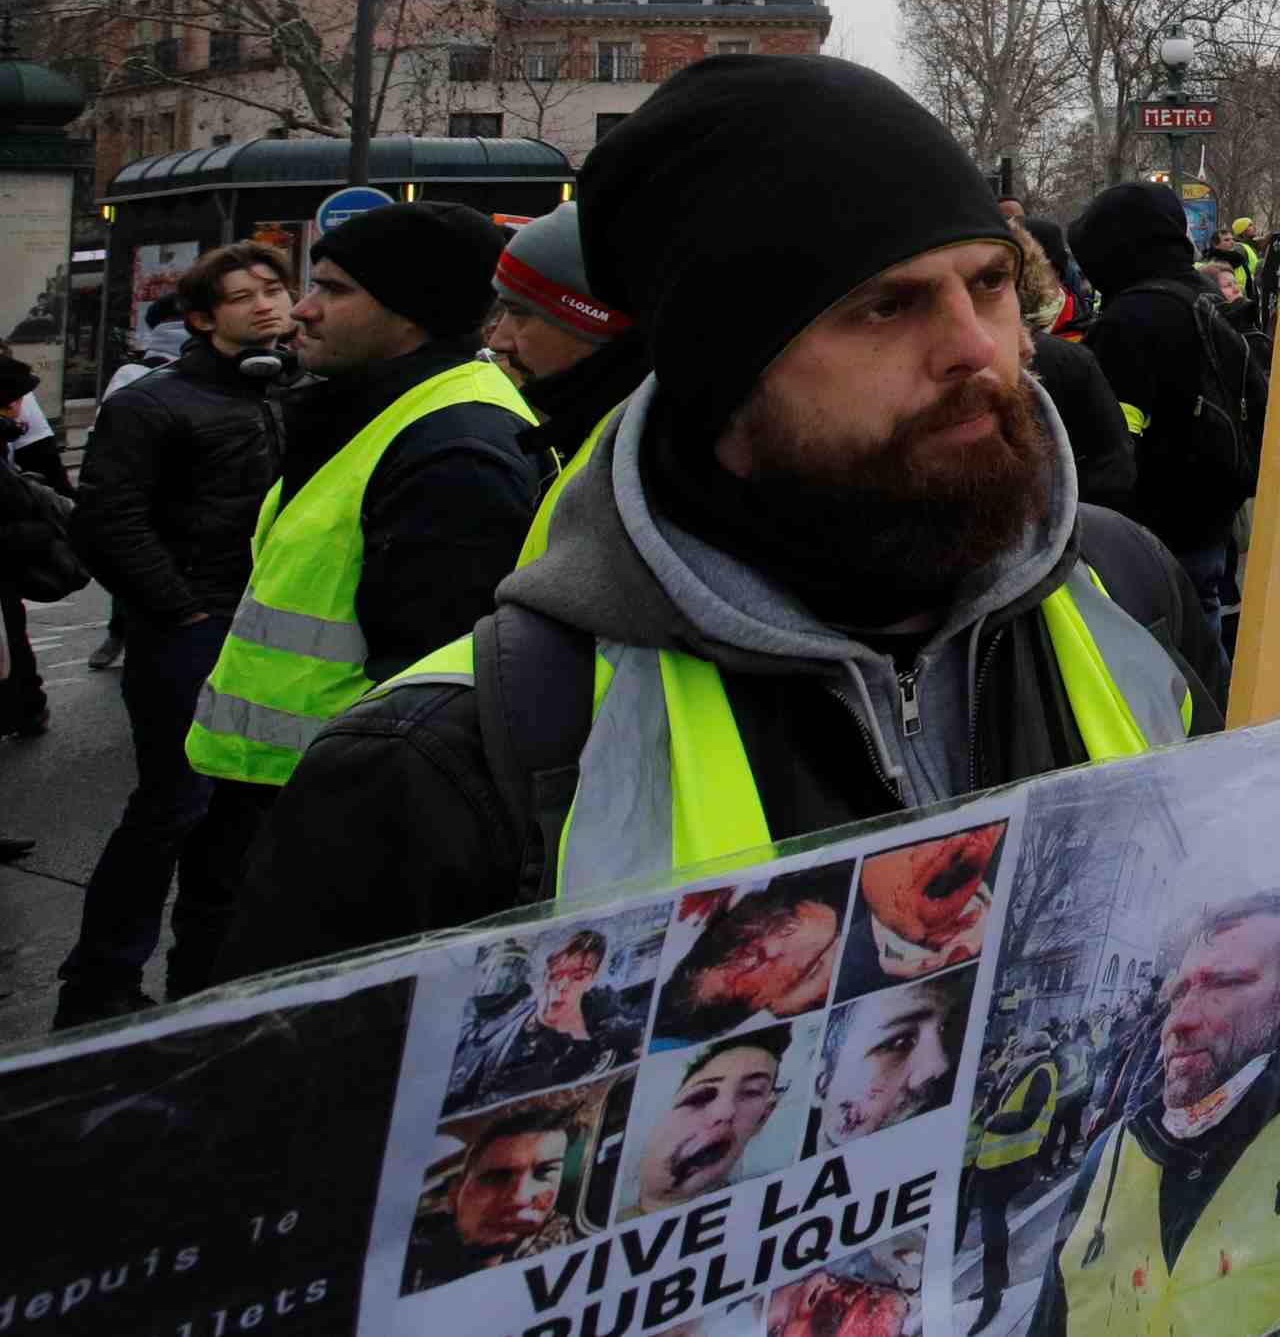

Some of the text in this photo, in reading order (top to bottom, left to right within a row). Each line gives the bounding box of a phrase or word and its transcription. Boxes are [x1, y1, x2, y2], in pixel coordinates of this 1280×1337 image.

[1144, 109, 1212, 127] METRO
[568, 297, 609, 322] LOXAM
[247, 1208, 299, 1245] le
[523, 1155, 851, 1313] VIVE LA
